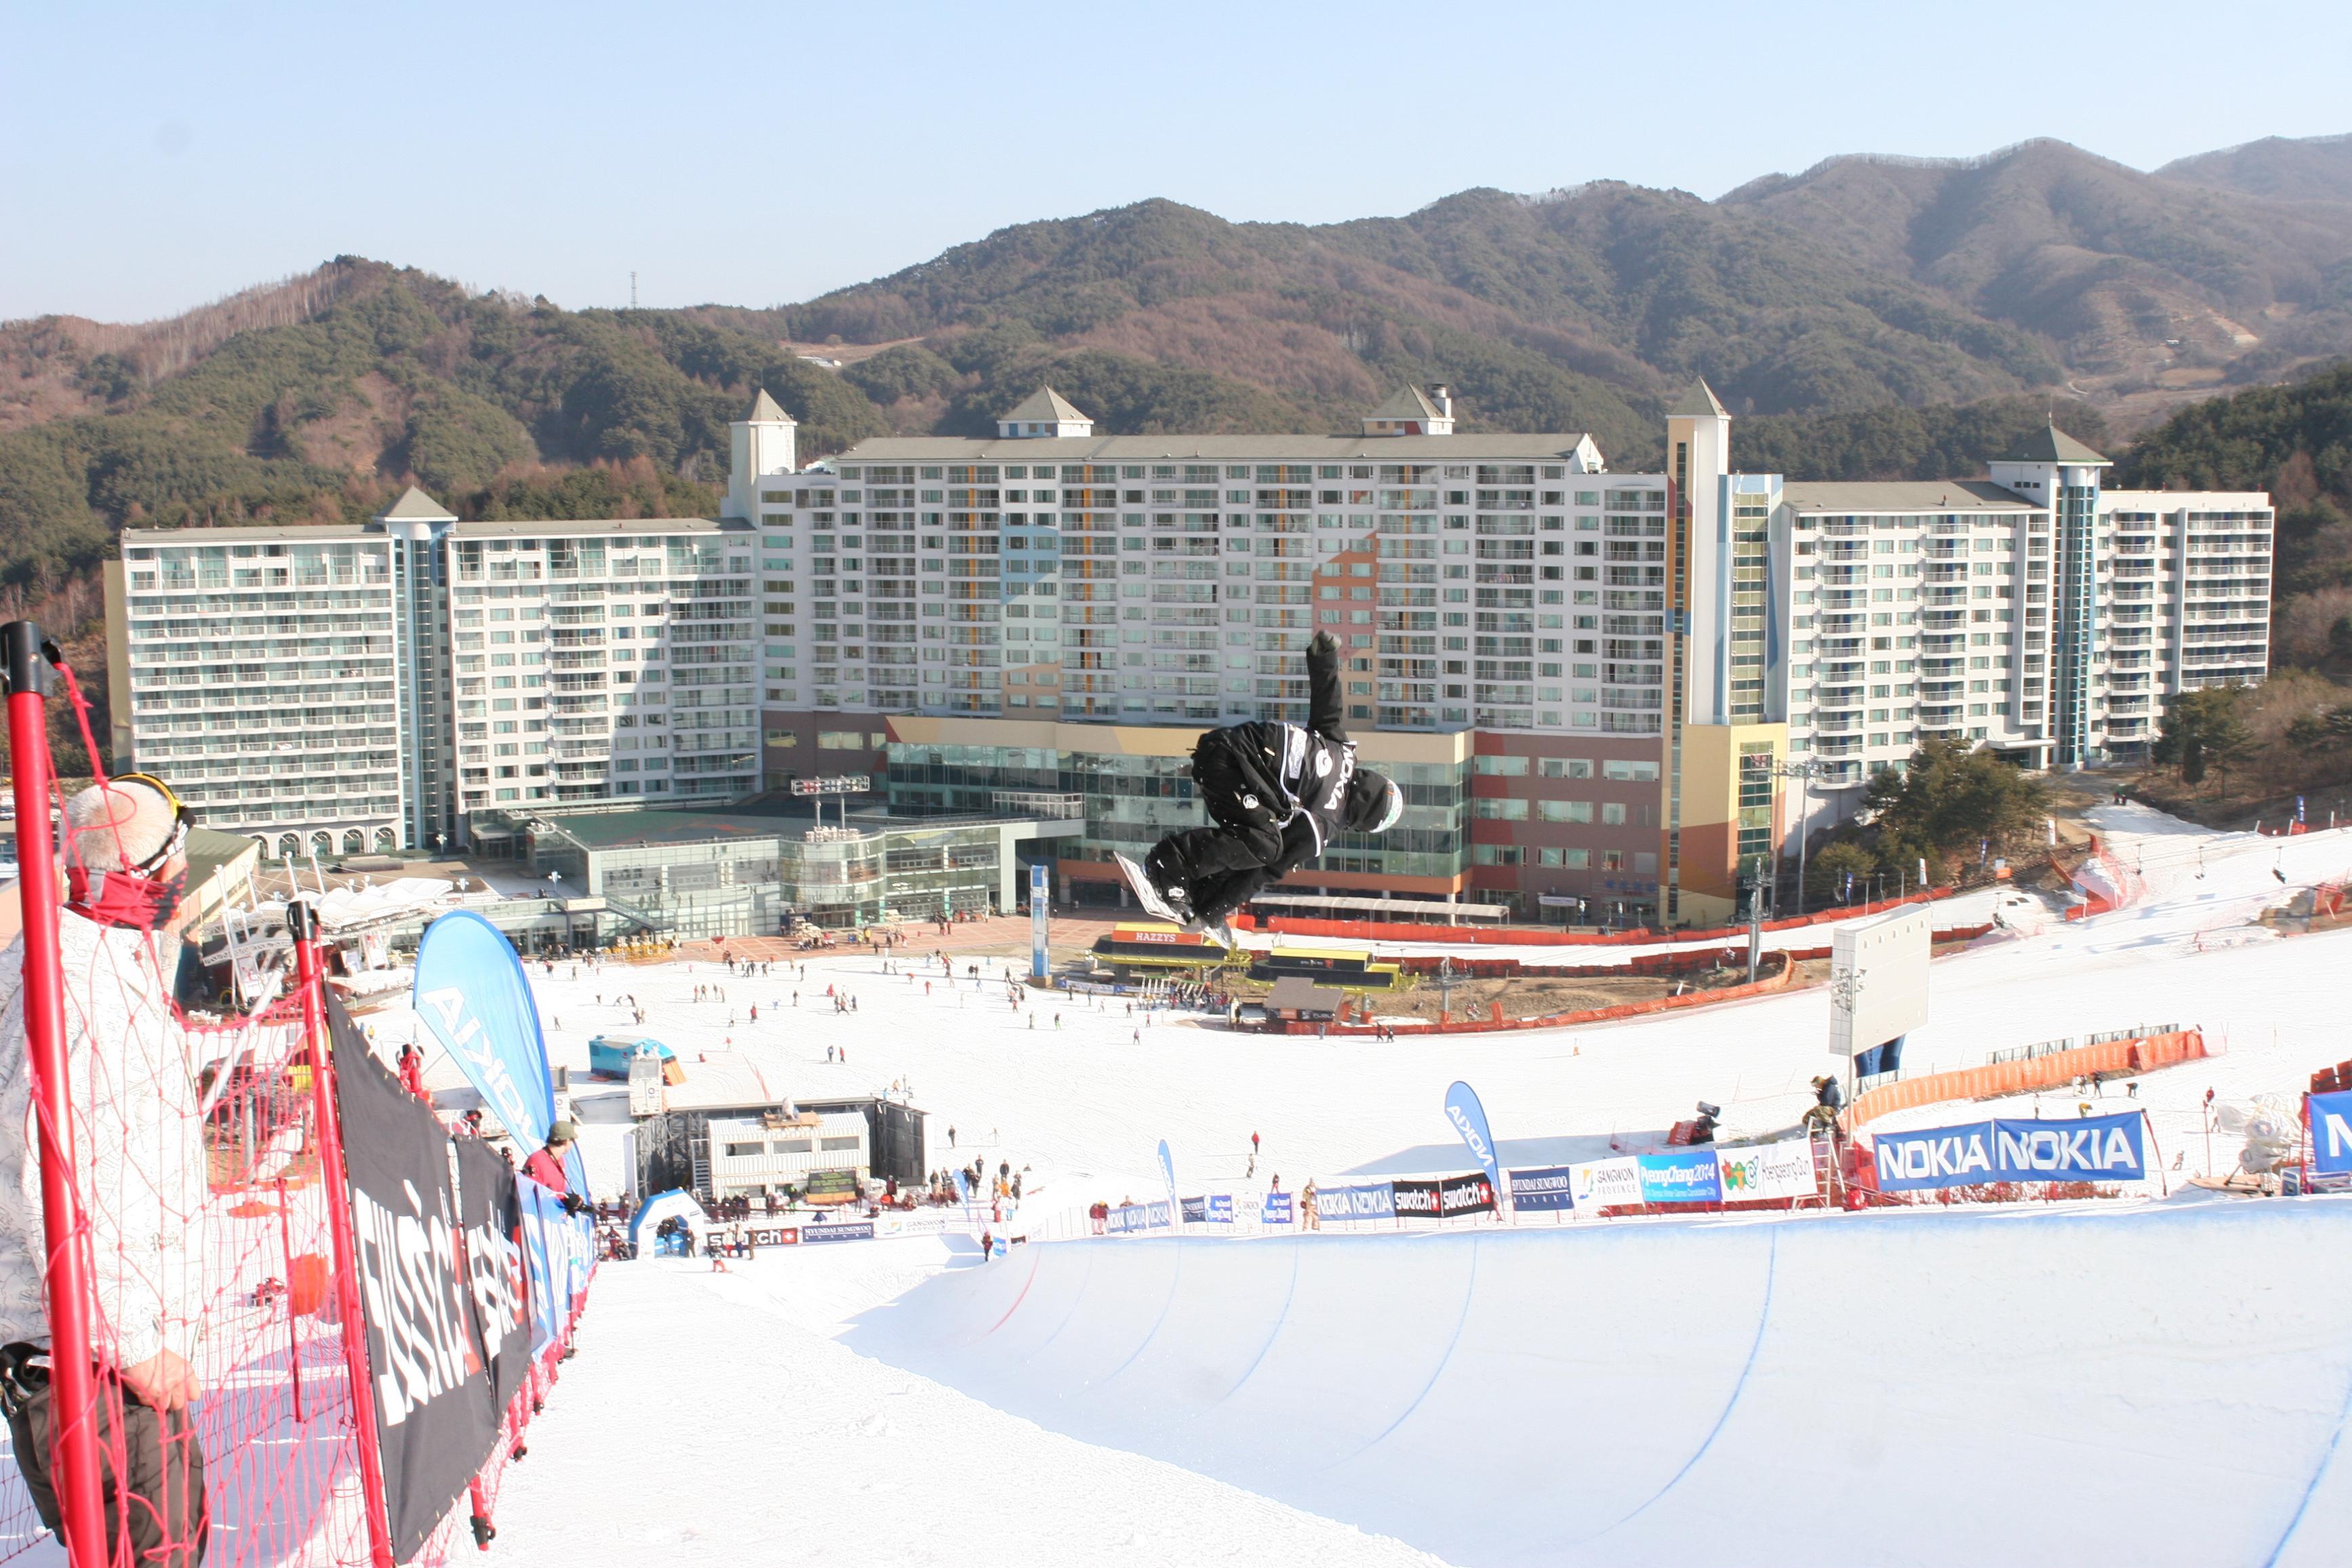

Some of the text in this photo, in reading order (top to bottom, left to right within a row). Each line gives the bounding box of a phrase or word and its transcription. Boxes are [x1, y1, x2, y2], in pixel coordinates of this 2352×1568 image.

[1324, 745, 1355, 810] NOKIA
[1136, 932, 1176, 942] HAZZYS
[1877, 1127, 2137, 1180] NOKIA NOKIA
[1317, 1190, 1393, 1215] NOKIA NOKIA
[1395, 1189, 1431, 1210] swatch
[1443, 1182, 1481, 1210] swatch
